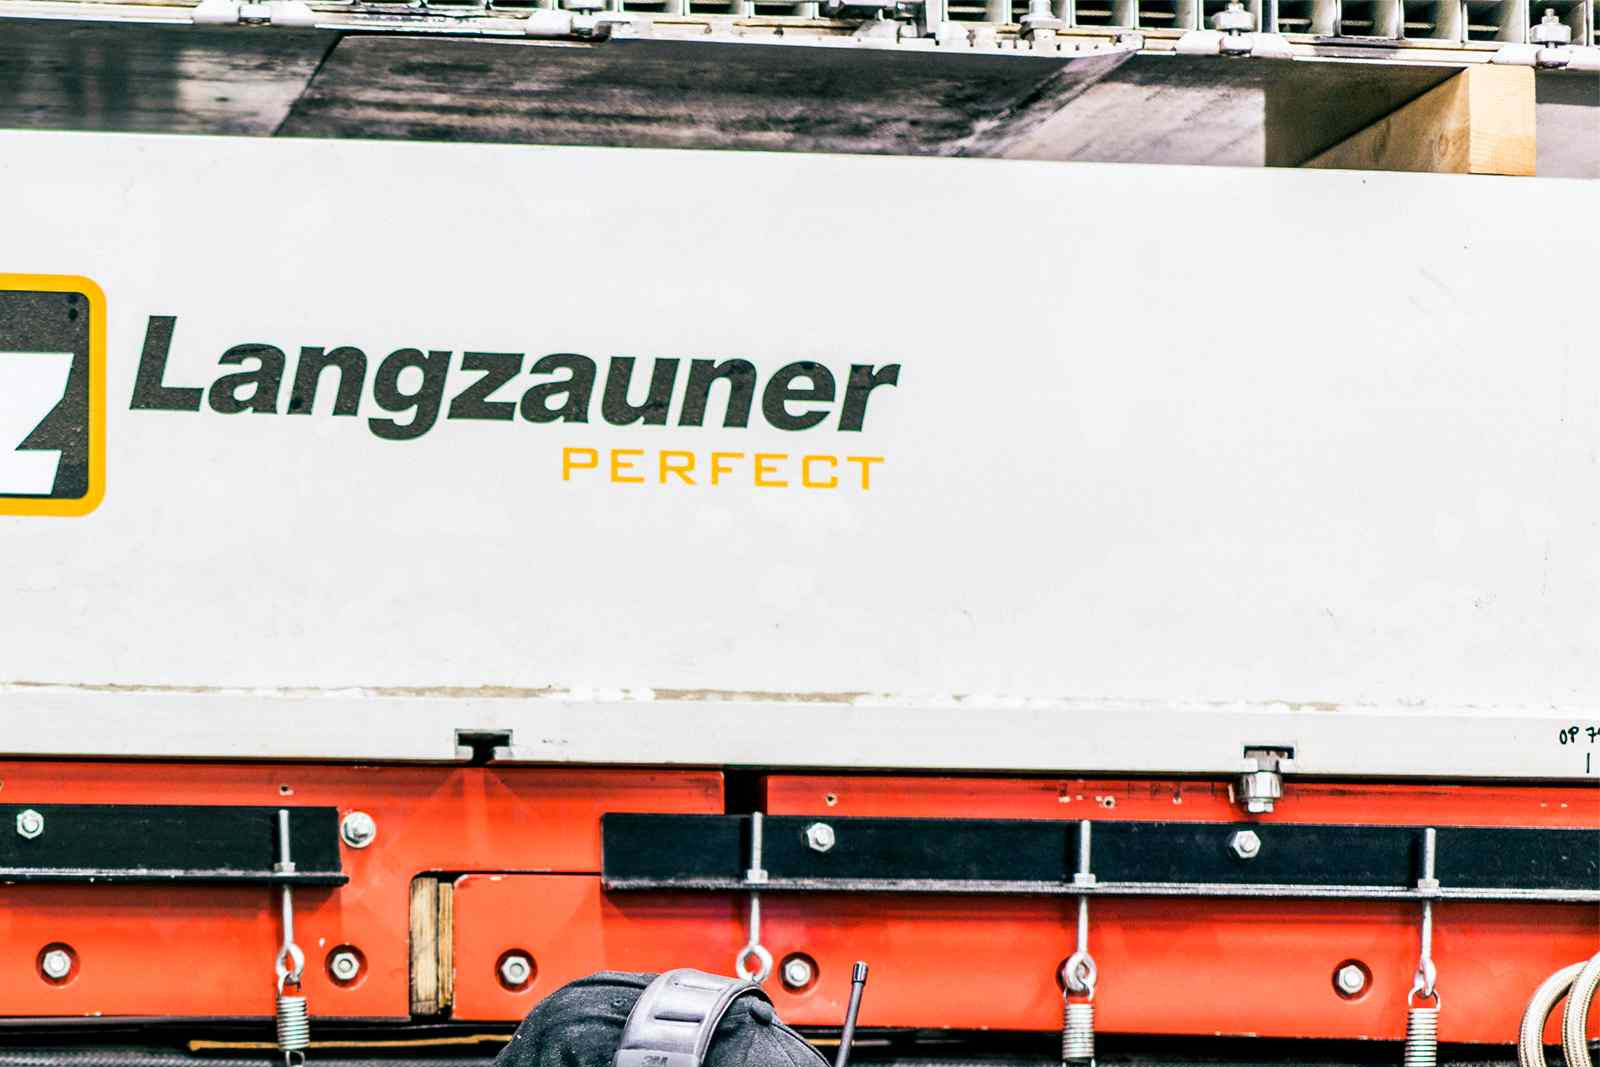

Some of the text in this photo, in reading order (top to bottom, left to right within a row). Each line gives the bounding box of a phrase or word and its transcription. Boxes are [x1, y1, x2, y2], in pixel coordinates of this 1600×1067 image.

[129, 314, 901, 441] Langzauner
[561, 447, 885, 490] PERFECT
[1585, 726, 1600, 744] 7
